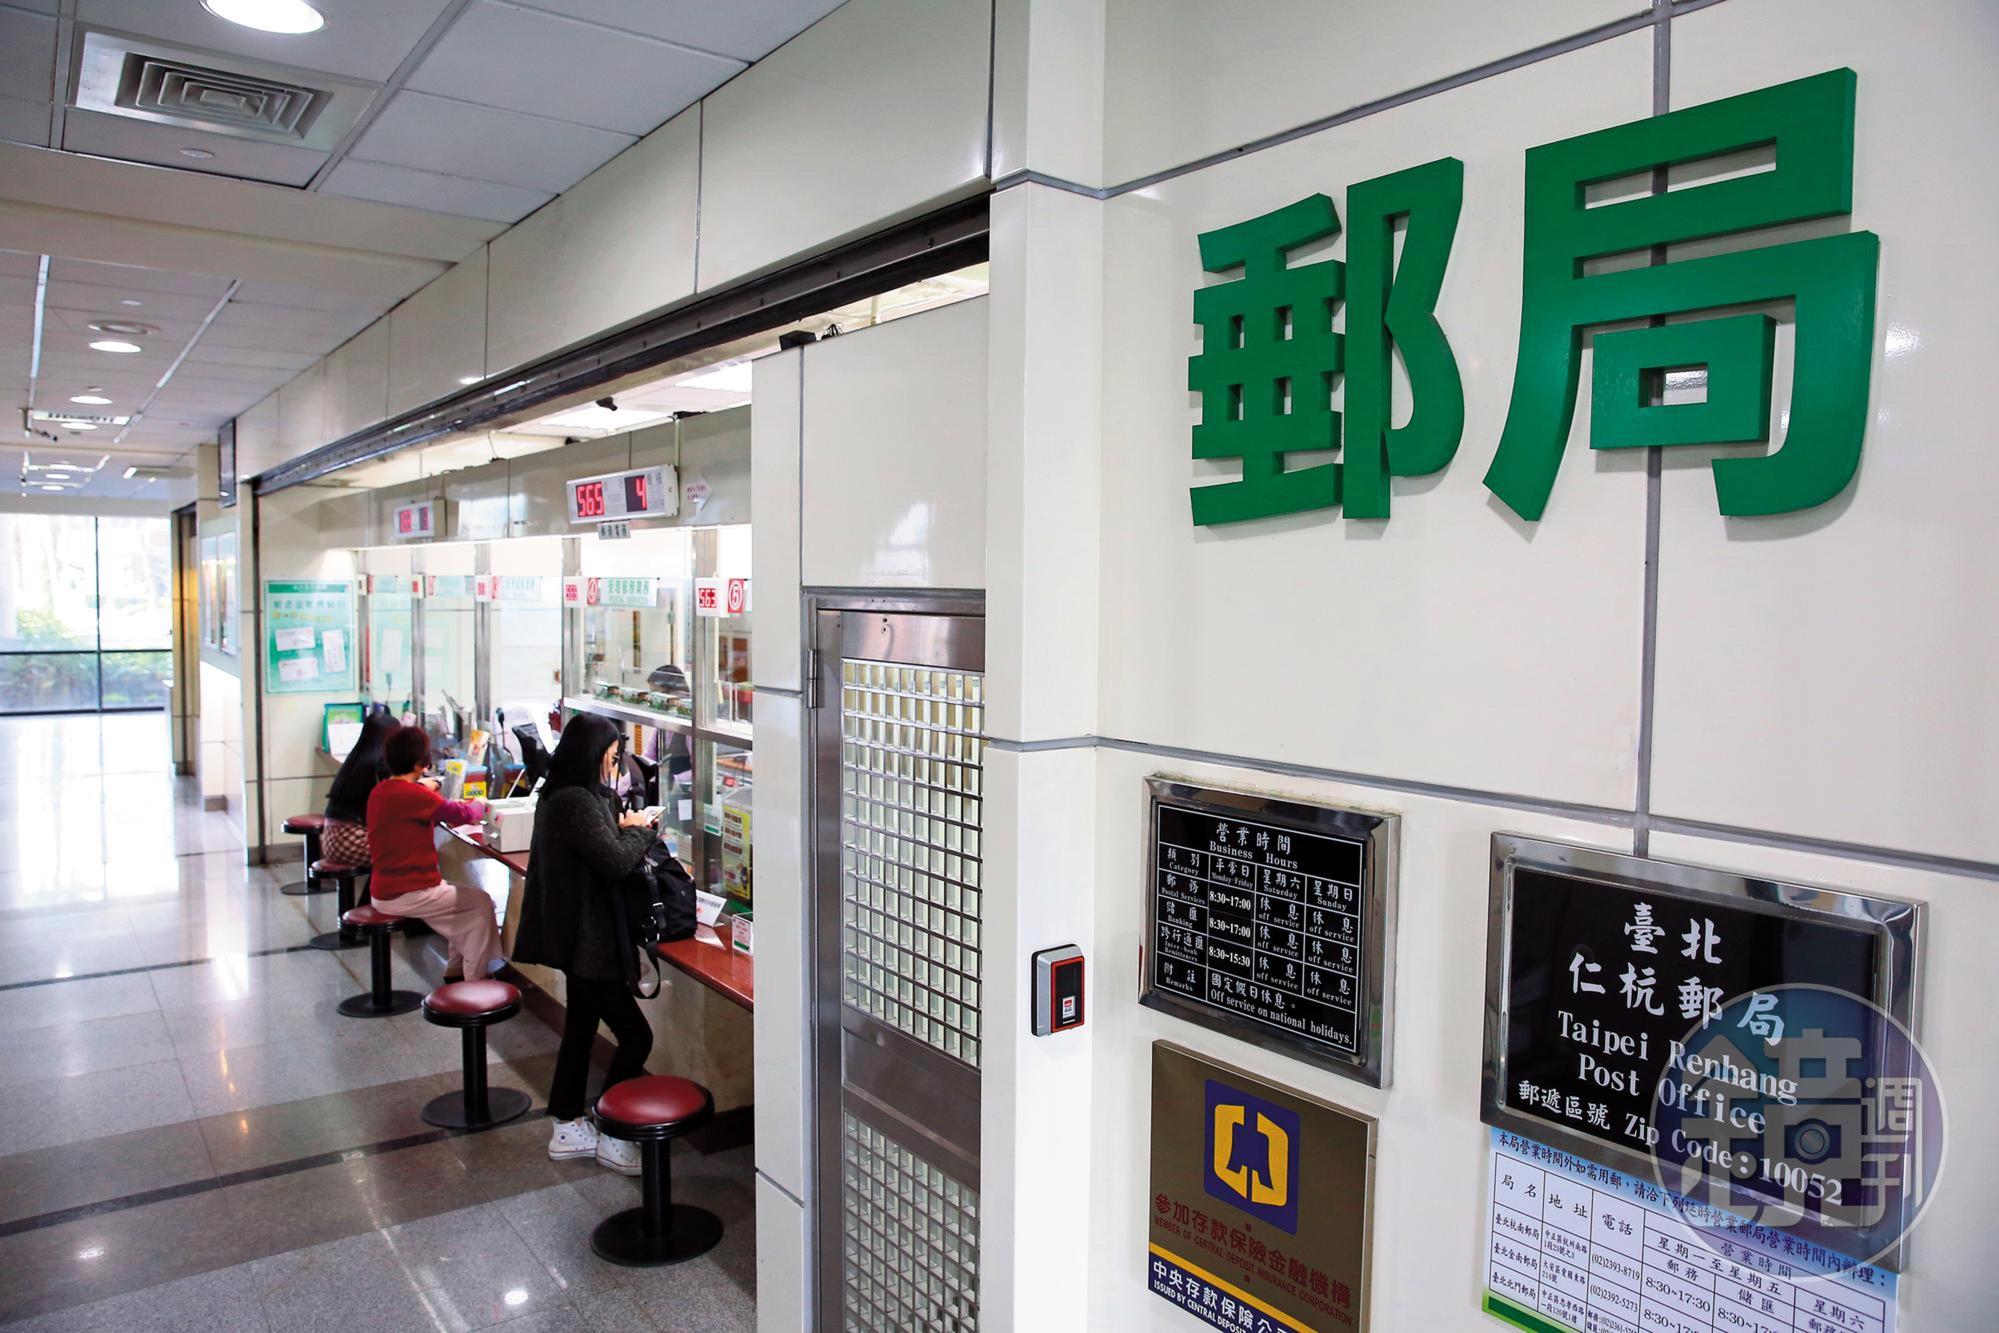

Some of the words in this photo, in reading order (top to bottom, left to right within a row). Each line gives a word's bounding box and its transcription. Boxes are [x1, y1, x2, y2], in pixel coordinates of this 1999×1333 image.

[1188, 67, 1878, 526] 郵局
[635, 478, 647, 510] 4
[1216, 822, 1291, 855] 營業時間
[1210, 841, 1253, 860] Business
[1266, 853, 1298, 870] Hours
[1169, 861, 1199, 876] Category
[1215, 858, 1250, 878] 平常日
[1263, 869, 1300, 890] 星期六
[1161, 886, 1179, 899] Postal
[1180, 892, 1206, 905] Services
[1166, 873, 1199, 894] 郵務
[1263, 885, 1298, 900] Saturday
[1313, 880, 1353, 902] 星期日
[1166, 900, 1197, 921] 儲匯
[1209, 890, 1251, 911] 8:30~17:00
[1260, 896, 1299, 920] 休息
[1317, 897, 1347, 912] Sunday
[1209, 917, 1250, 938] 8:30~17:00
[1258, 912, 1270, 921] off
[1273, 915, 1300, 929] service
[1313, 911, 1354, 934] 休息
[1161, 925, 1204, 950] 跨行通匯
[1259, 925, 1298, 950] 休息
[1309, 925, 1322, 935] off
[1324, 929, 1355, 943] service
[1624, 902, 1723, 965] 臺北
[1208, 945, 1250, 968] 8:30~15:30
[1257, 940, 1270, 950] off
[1272, 943, 1299, 958] service
[1312, 940, 1353, 964] 休息
[1259, 956, 1296, 979] 休息
[1308, 954, 1321, 964] off
[1323, 959, 1354, 973] service
[1166, 976, 1193, 992] Remarks
[1256, 970, 1269, 980] off
[1270, 974, 1299, 990] service
[1310, 971, 1350, 995] 休息
[1306, 986, 1320, 997] off
[1322, 990, 1352, 1006] service
[1569, 952, 1785, 1047] 仁杭郵局
[1211, 989, 1224, 1006] Off
[1226, 995, 1255, 1014] service
[1257, 1005, 1268, 1018] on
[1270, 1008, 1306, 1030] national
[1310, 1020, 1352, 1045] holidays.
[1558, 1010, 1649, 1061] Taipei
[1668, 1040, 1799, 1106] Renhang
[1519, 1079, 1611, 1130] 郵遞區號
[1578, 1053, 1640, 1097] Post
[1658, 1077, 1766, 1134] Office
[1625, 1112, 1660, 1146] Zip
[1759, 1157, 1843, 1206] 10052
[1502, 1174, 1537, 1198] 局名
[1549, 1194, 1587, 1219] 地址
[1602, 1213, 1633, 1236] 電話
[1155, 1194, 1351, 1310] 參加存款保險金融機構
[1721, 1241, 1792, 1279] 營業時間
[1154, 1215, 1181, 1236] MEMBER
[1183, 1228, 1192, 1240] OF
[1194, 1233, 1223, 1258] CENTRAL
[1226, 1251, 1254, 1273] DEPOSIT
[1257, 1268, 1296, 1296] INSURANCE
[1300, 1290, 1351, 1326] CORPORATION
[1592, 1254, 1640, 1281] (02)2393-8719
[1658, 1236, 1781, 1295] 星期一至星期五
[1667, 1259, 1698, 1281] 郵務
[1153, 1261, 1287, 1333] 中央存款保險公
[1154, 1279, 1176, 1299] ISSUED
[1177, 1292, 1186, 1304] BY
[1187, 1299, 1216, 1323] CENTRAL
[1590, 1284, 1639, 1313] (02)2392-5273
[1645, 1276, 1711, 1313] 8:30~17:30
[1739, 1288, 1774, 1314] 儲匯
[1813, 1299, 1865, 1330] 星期六
